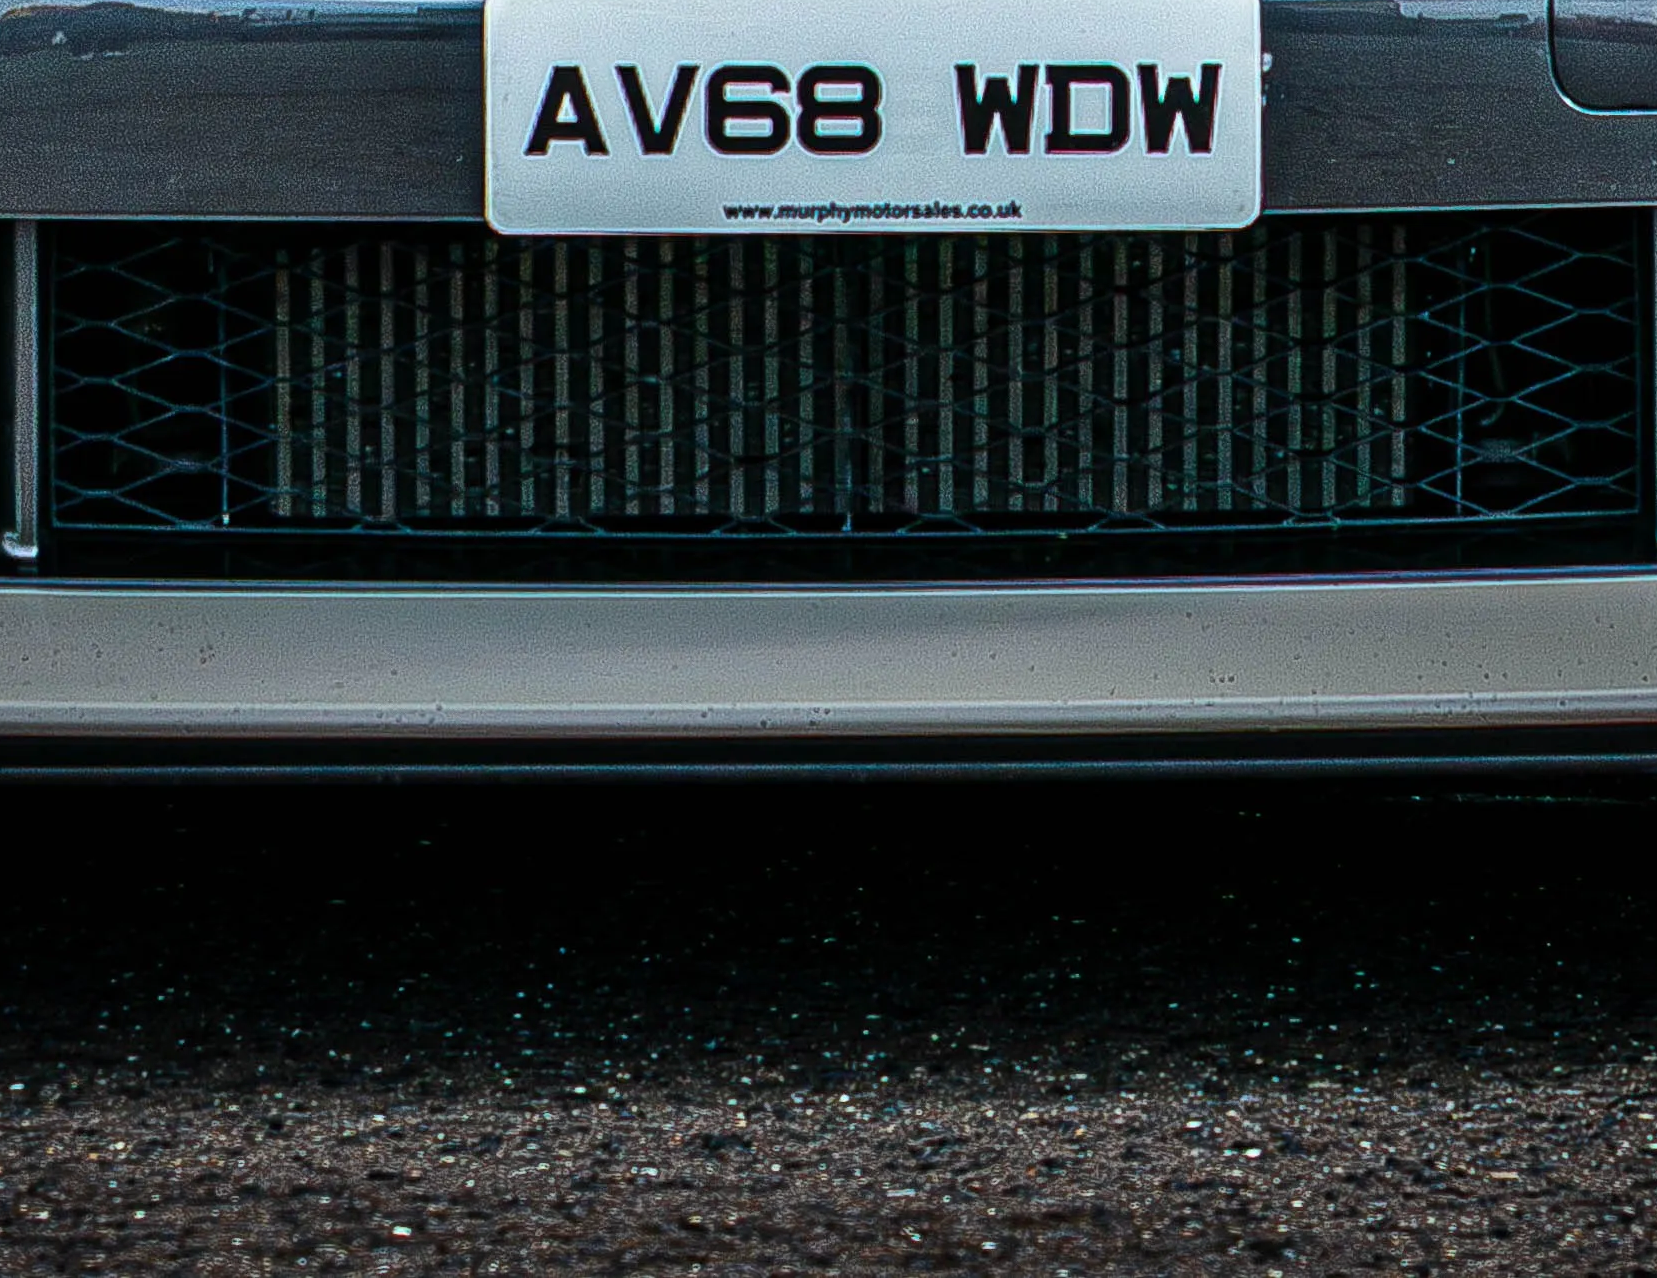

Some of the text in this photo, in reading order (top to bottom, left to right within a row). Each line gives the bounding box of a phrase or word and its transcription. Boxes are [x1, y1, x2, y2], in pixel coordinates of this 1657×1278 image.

[524, 62, 1223, 156] AV68 WDW
[723, 201, 1023, 223] www.murphymotorsales.co.uk
